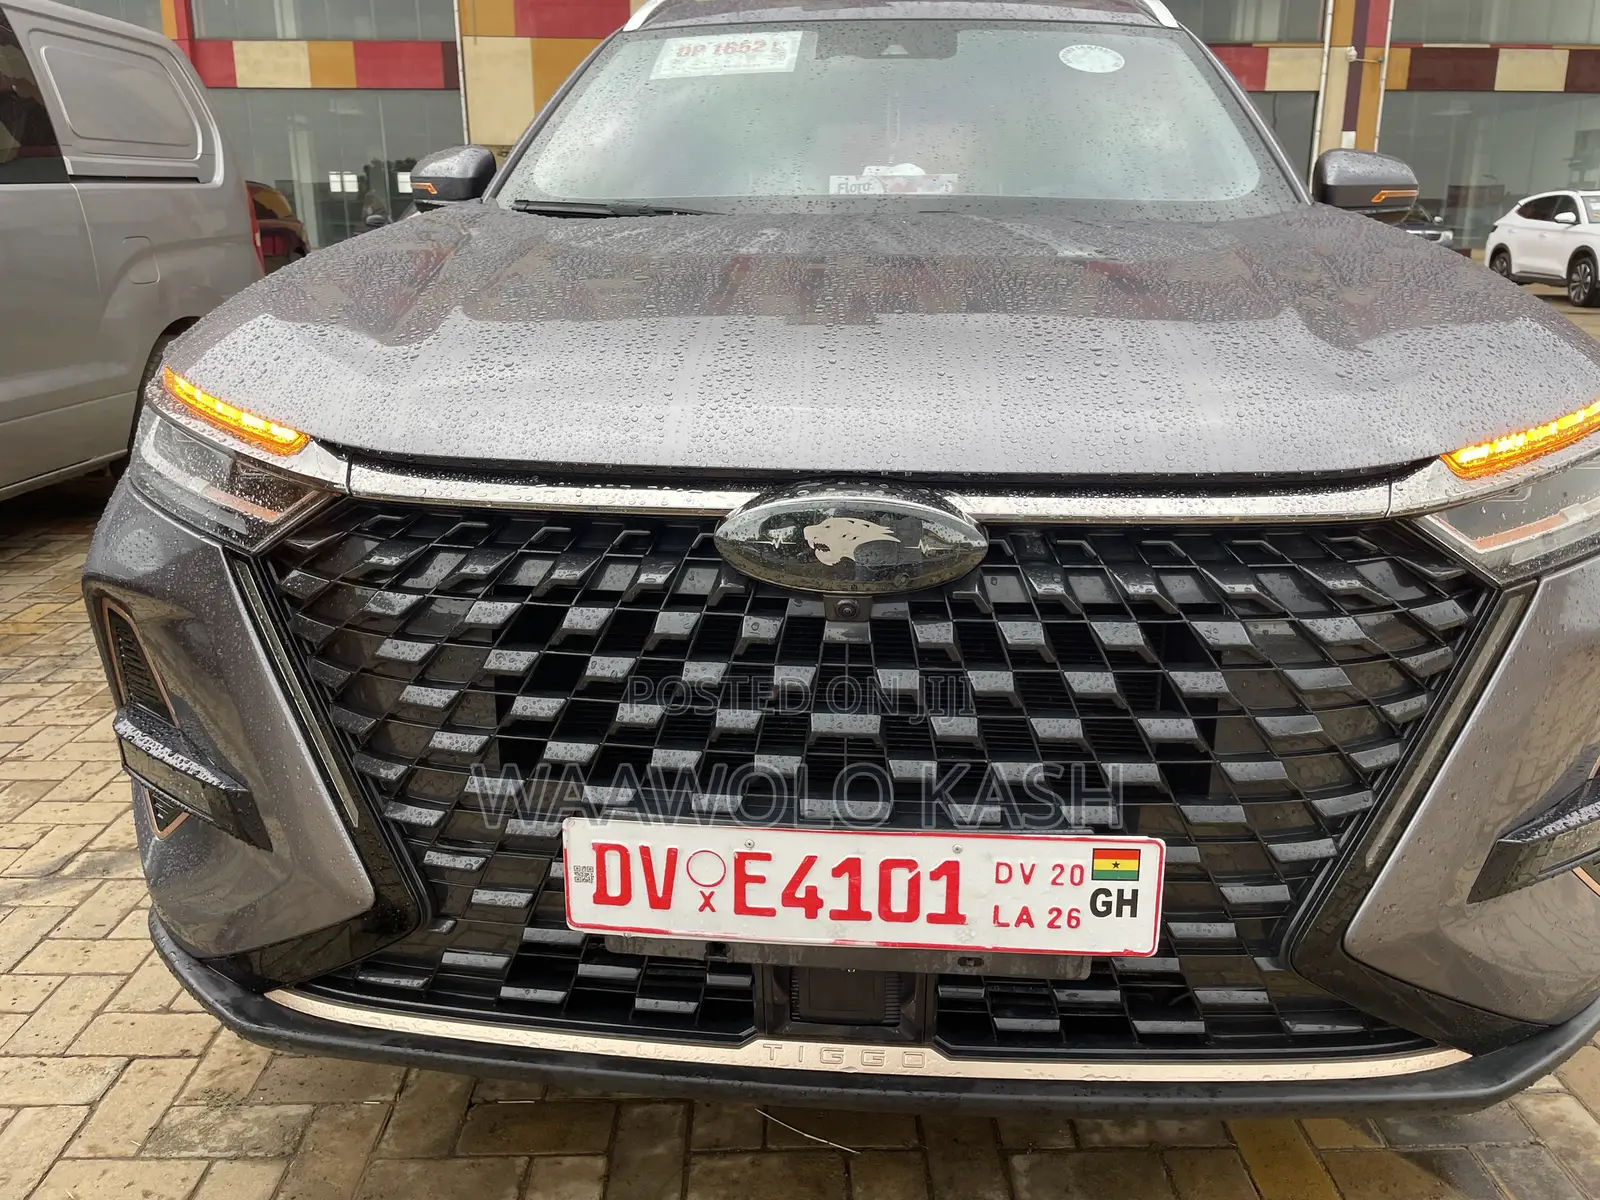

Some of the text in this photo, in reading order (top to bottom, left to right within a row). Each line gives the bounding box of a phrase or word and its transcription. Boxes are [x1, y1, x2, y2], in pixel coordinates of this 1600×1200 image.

[591, 842, 679, 910] DV
[733, 851, 967, 925] E4101
[994, 861, 1085, 887] DV 20
[1089, 887, 1140, 918] GH
[992, 904, 1082, 930] LA 26
[762, 1043, 926, 1069] TIGGO
